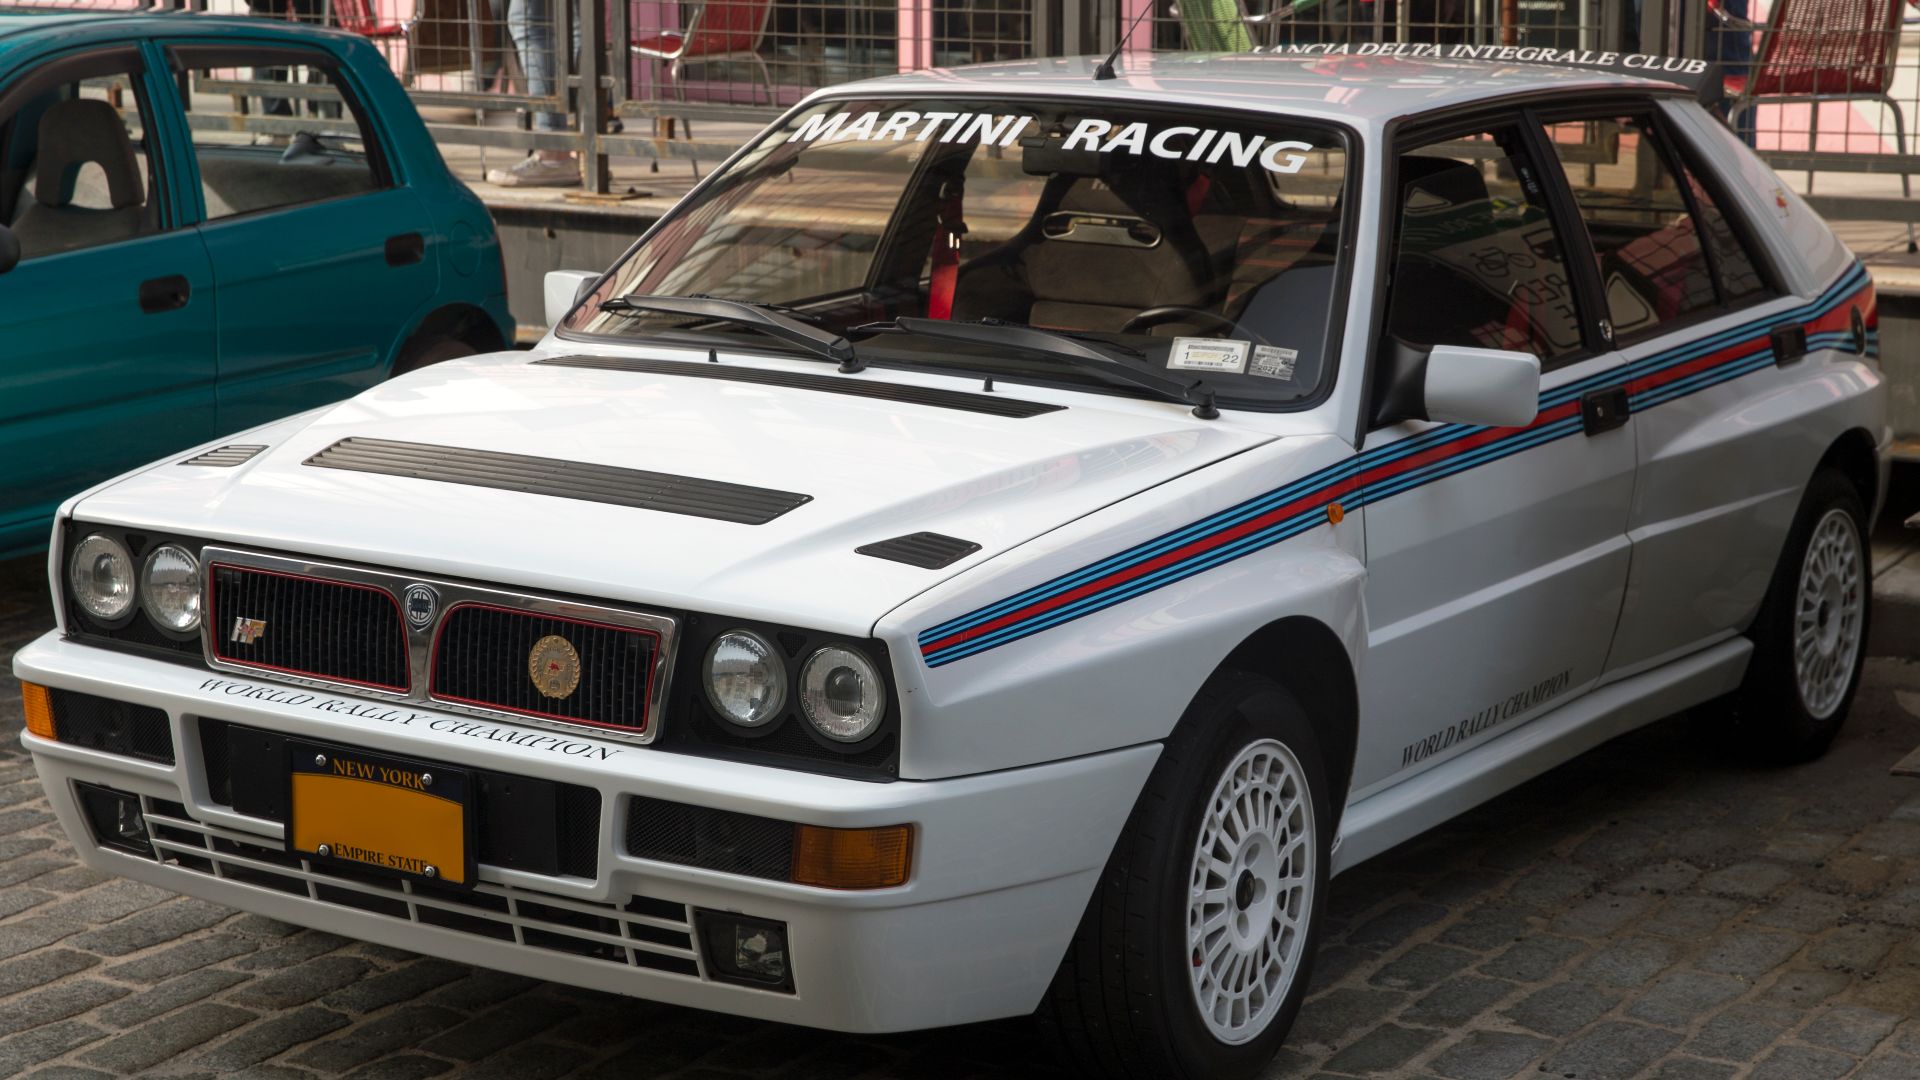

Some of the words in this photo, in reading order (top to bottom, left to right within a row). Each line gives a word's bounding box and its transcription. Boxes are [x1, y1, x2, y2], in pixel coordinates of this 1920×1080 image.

[1252, 42, 1350, 55] LANCIA
[1355, 42, 1442, 57] DELTA
[1447, 44, 1619, 66] INTEGRALE
[1622, 53, 1708, 74] CLUB
[786, 111, 1033, 146] MARTINI
[1061, 118, 1314, 174] RACING
[1221, 353, 1239, 364] 22
[231, 616, 267, 645] HF
[198, 678, 315, 706] WORLD
[312, 699, 433, 725] RALLY
[429, 718, 624, 761] CHAMPION
[1401, 725, 1456, 768] WORLD
[1455, 702, 1504, 744] RALLY
[1502, 668, 1574, 720] CHAMPION
[332, 758, 375, 779] NEW
[379, 766, 425, 790] YORK
[334, 842, 385, 865] EMPIRE
[388, 855, 428, 874] STATE
